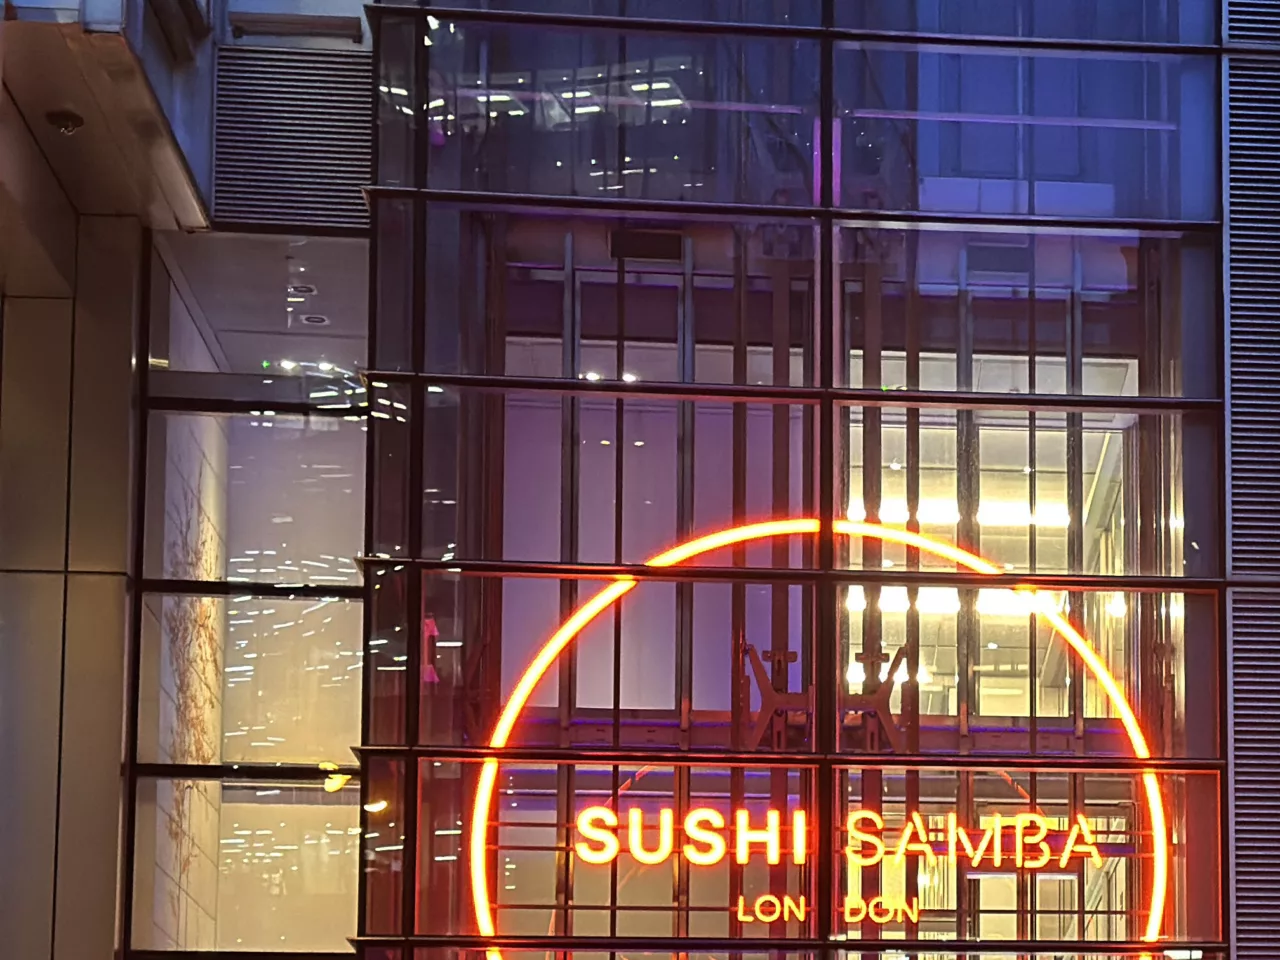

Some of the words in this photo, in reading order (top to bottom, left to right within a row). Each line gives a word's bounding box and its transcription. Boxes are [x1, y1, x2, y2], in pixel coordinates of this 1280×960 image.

[574, 806, 807, 865] SUSHI
[844, 809, 1103, 869] SAMBA
[737, 895, 806, 922] LON
[844, 896, 920, 924] DON
